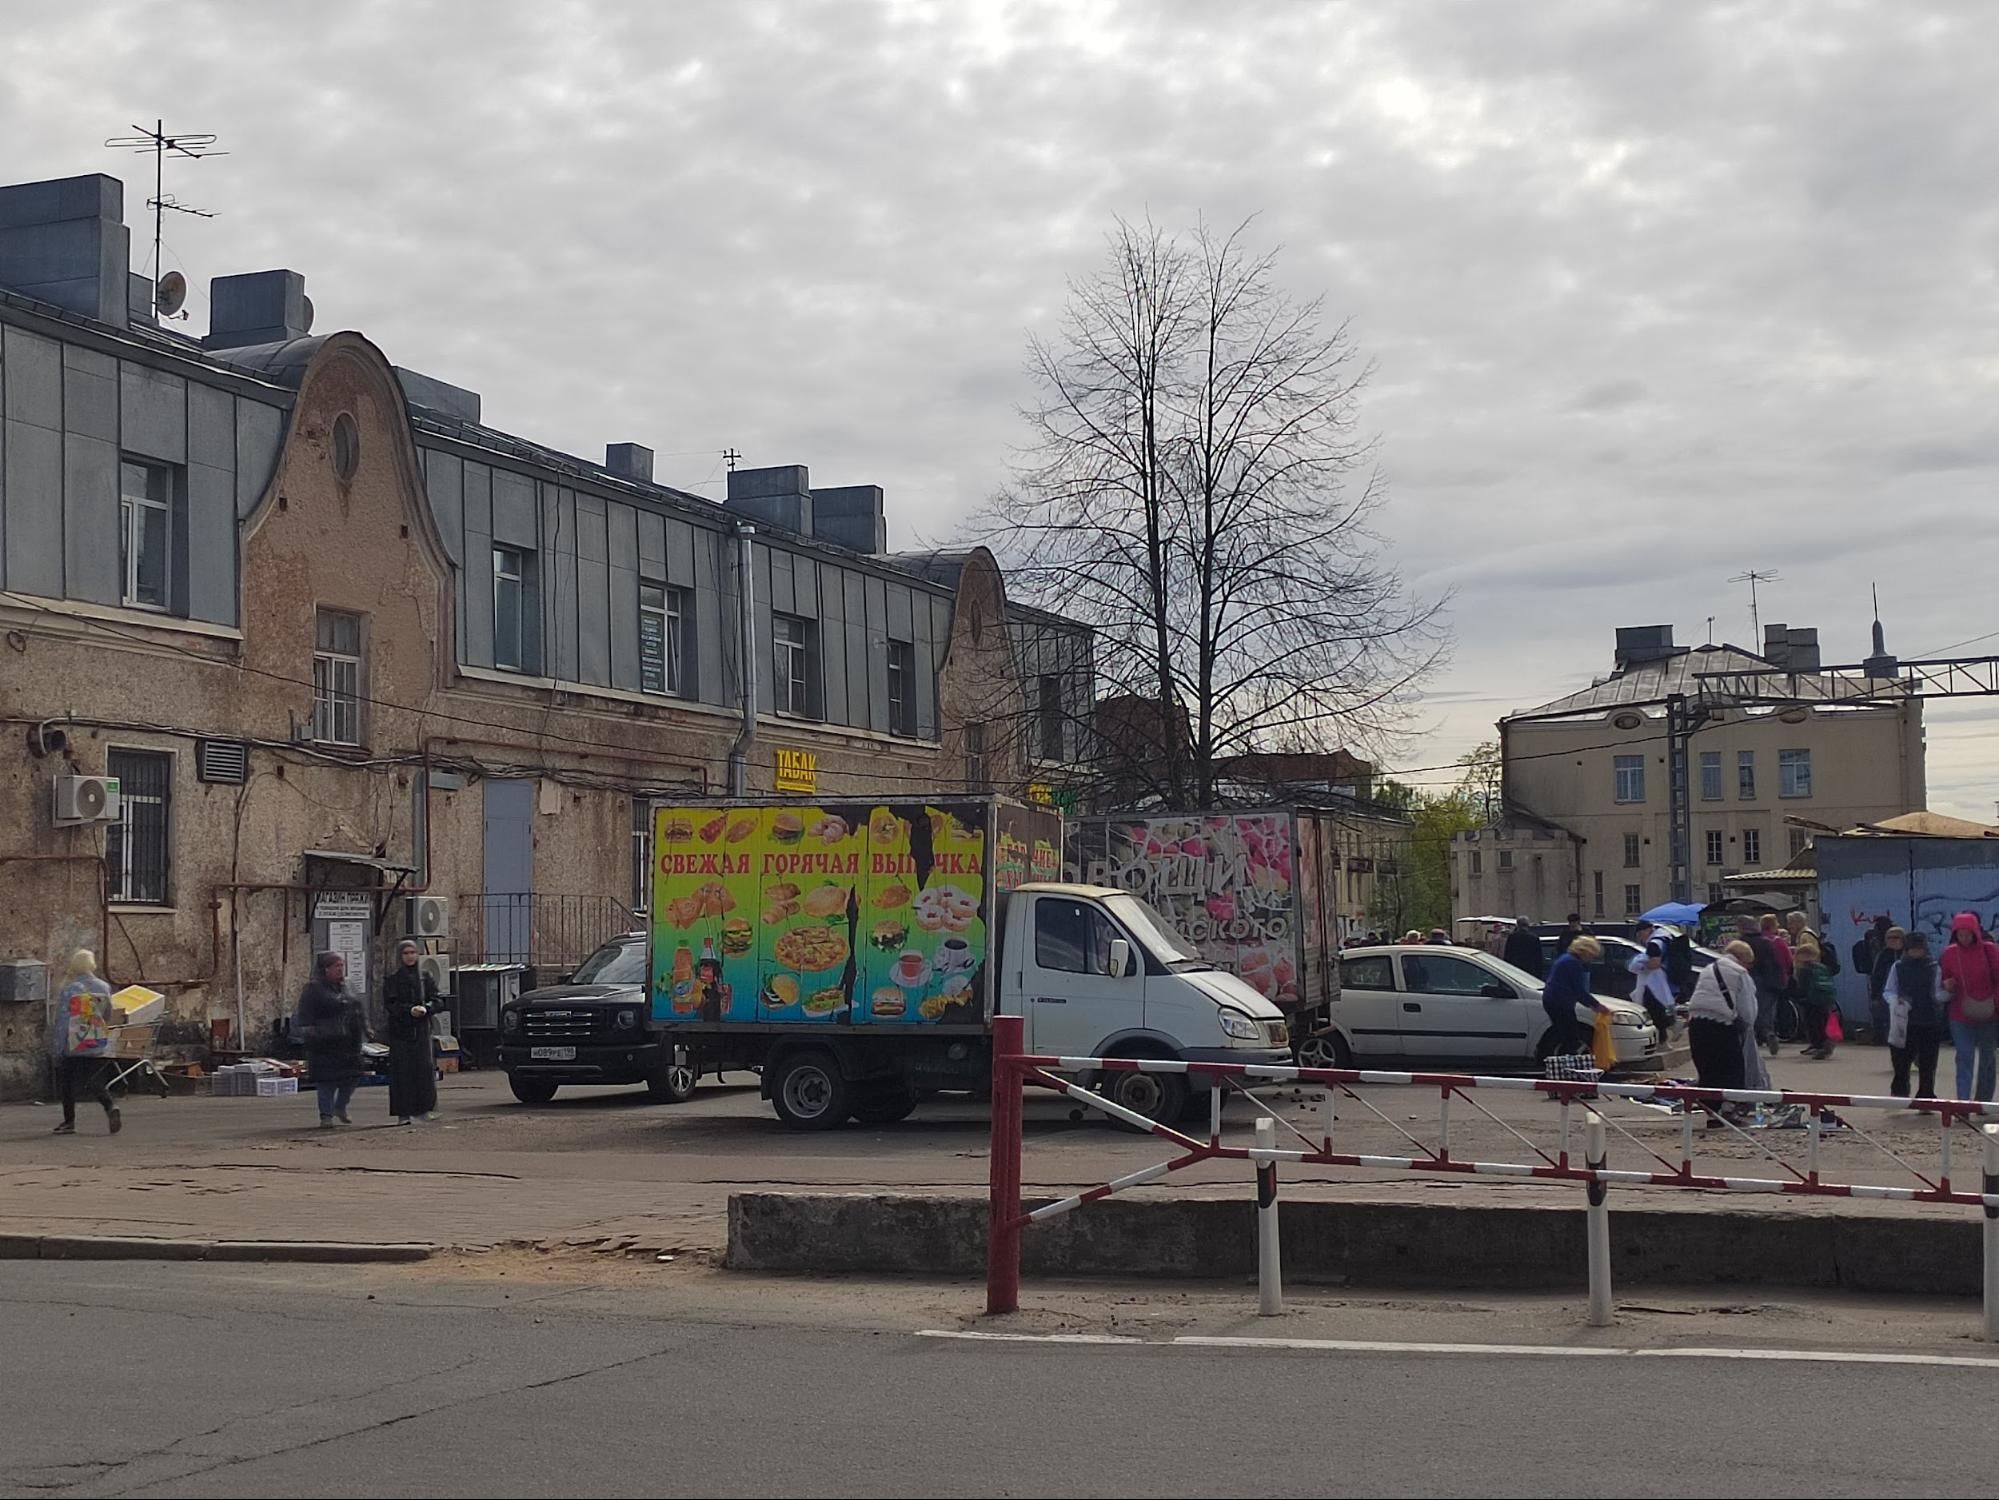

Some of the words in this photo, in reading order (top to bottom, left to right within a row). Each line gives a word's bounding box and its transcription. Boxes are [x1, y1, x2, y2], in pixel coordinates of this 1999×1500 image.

[777, 749, 816, 781] ТАБАК
[660, 852, 751, 875] СВЕЖАЯ
[763, 852, 860, 875] ГОРЯЧАЯ
[871, 852, 982, 875] ВЫЧКА
